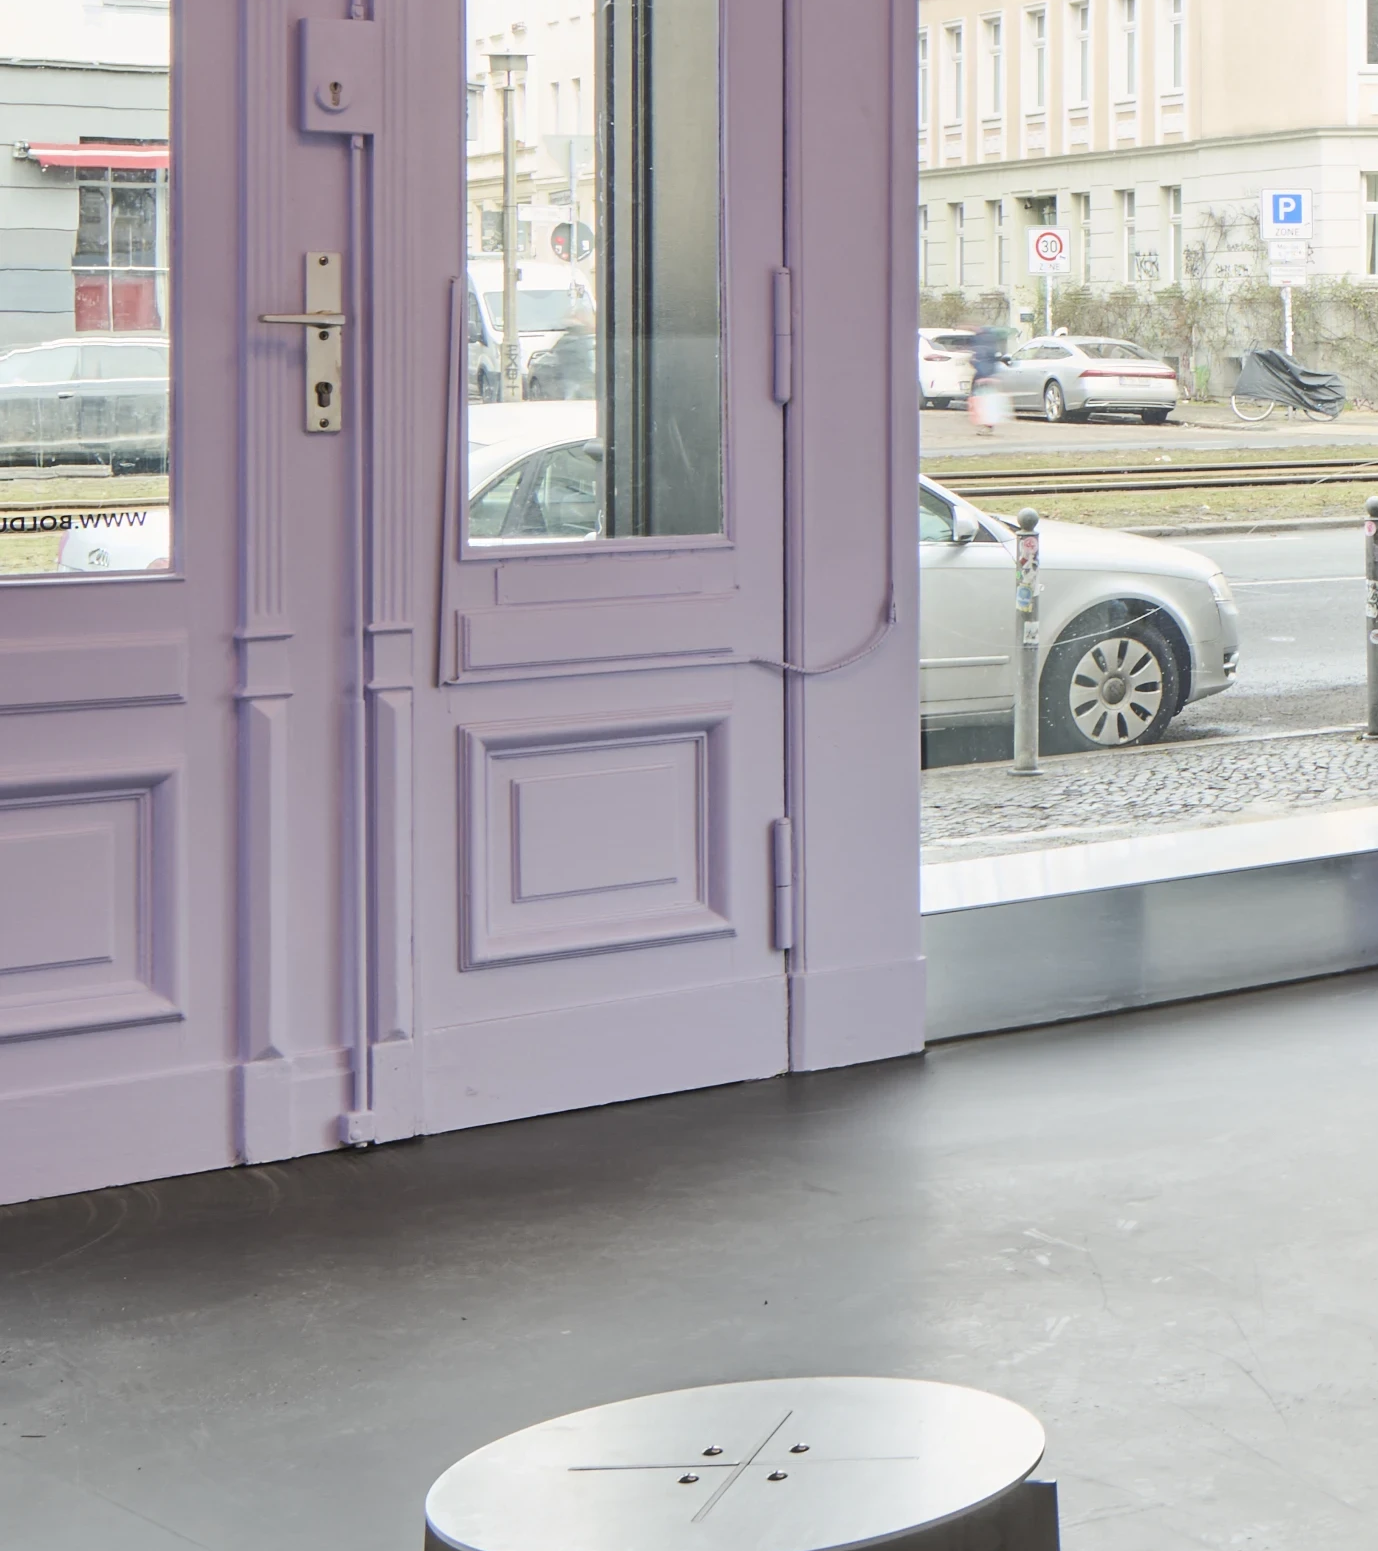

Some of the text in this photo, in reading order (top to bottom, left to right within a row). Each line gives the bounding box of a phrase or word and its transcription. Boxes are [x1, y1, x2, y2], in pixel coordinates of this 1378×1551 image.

[1278, 197, 1296, 221] P
[1275, 227, 1301, 237] ZONE
[1041, 240, 1057, 253] 30
[1039, 262, 1060, 271] ZNE
